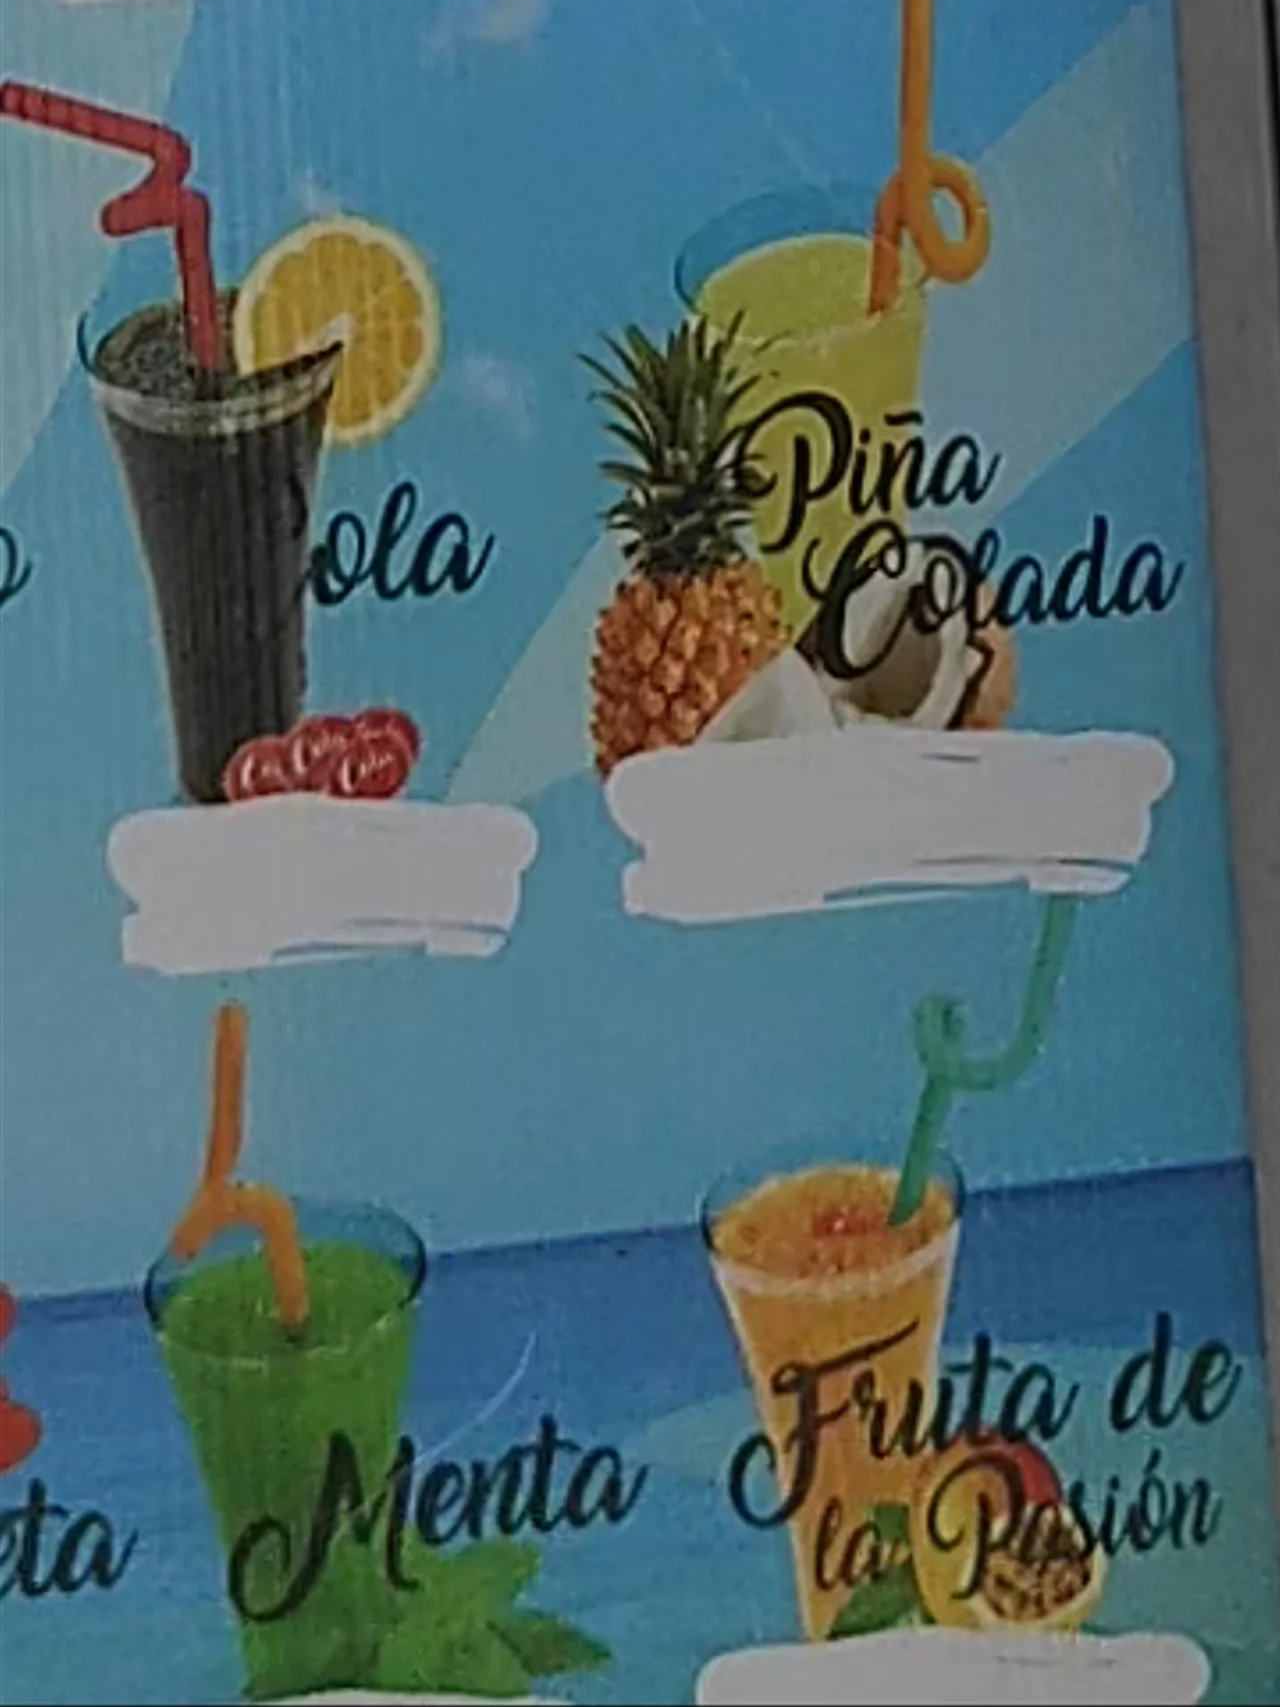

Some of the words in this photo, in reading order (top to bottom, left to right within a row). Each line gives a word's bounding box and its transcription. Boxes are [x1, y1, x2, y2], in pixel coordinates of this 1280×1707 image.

[734, 391, 1002, 555] Piña
[802, 514, 1185, 680] Colada
[729, 1320, 1080, 1528] Fruta
[1109, 1311, 1243, 1432] de
[228, 1415, 648, 1624] Menta
[814, 1498, 909, 1591] la
[928, 1447, 1222, 1600] Pasión
